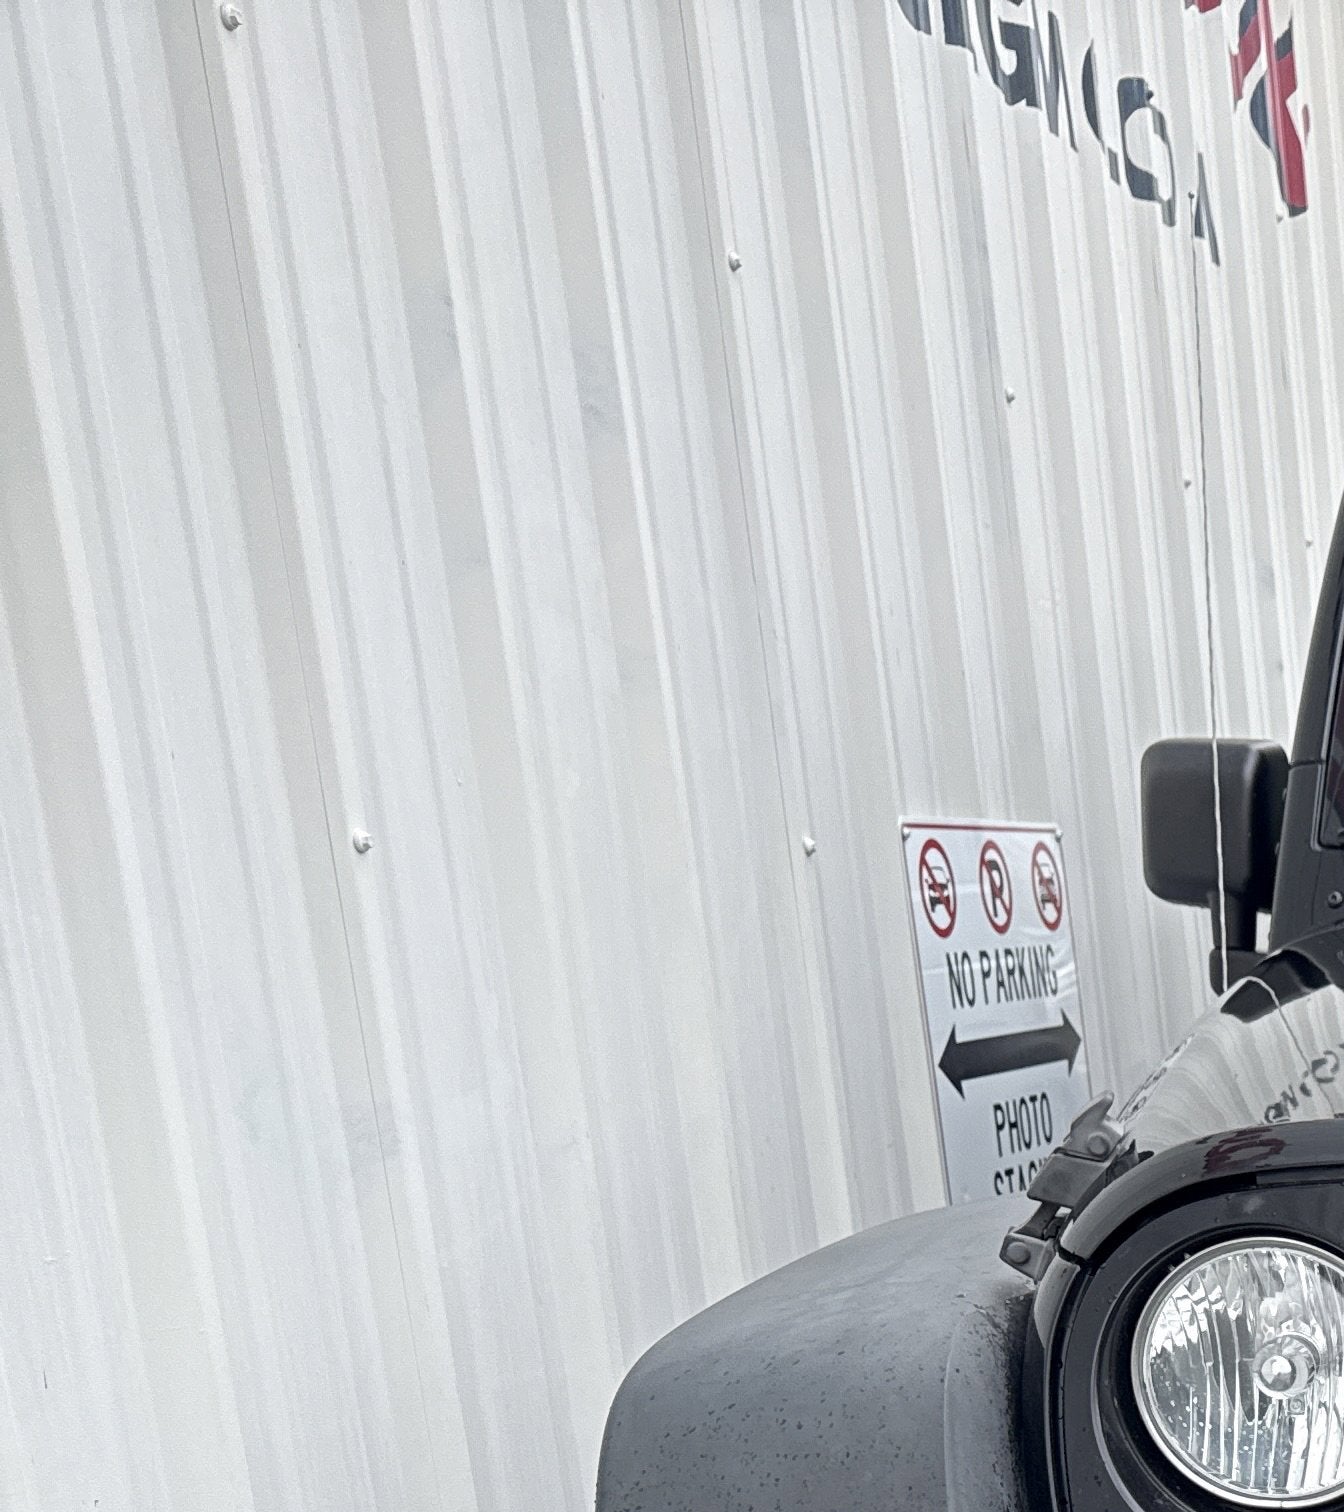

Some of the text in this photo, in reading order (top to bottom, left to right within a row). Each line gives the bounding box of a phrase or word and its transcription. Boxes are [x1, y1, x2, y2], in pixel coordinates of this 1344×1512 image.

[945, 944, 1059, 1010] NO PARKING
[992, 1091, 1054, 1158] PHOTO
